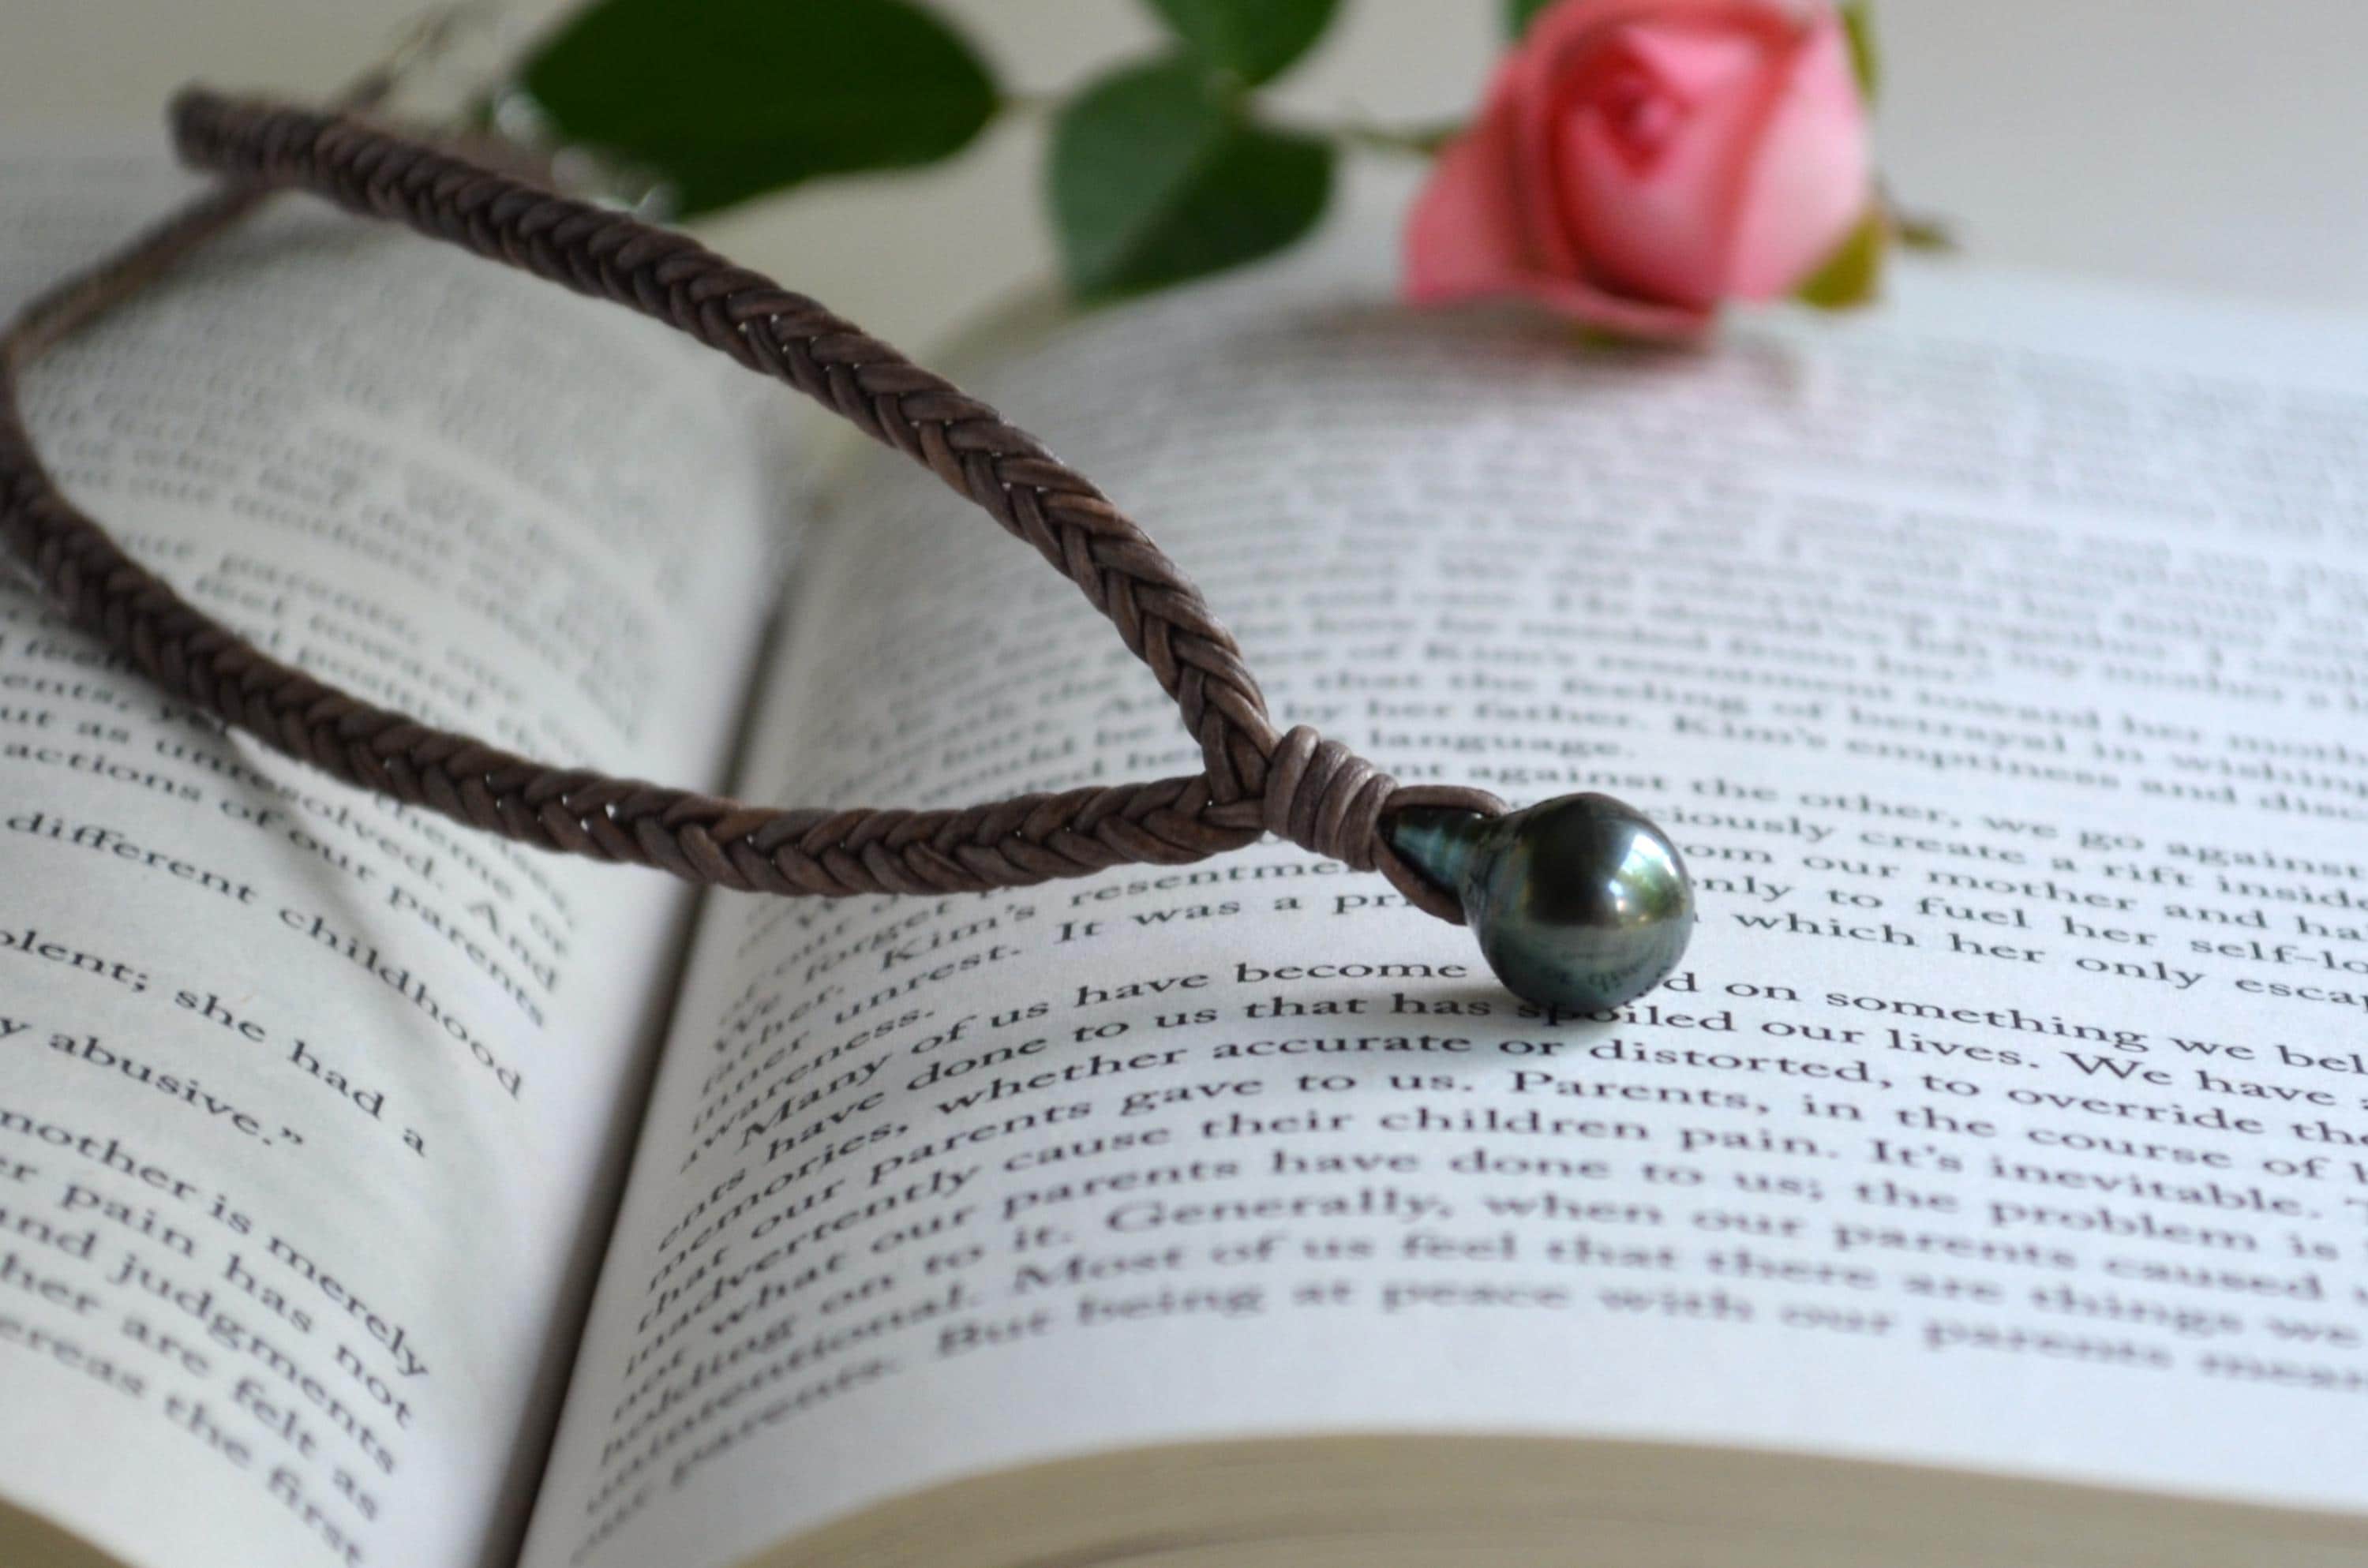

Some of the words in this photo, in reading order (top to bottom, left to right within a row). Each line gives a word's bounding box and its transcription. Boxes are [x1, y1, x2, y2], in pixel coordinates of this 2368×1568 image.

[1368, 728, 1639, 759] language.
[1672, 713, 1829, 751] Kim's
[1844, 735, 2122, 789] emptiness
[2138, 778, 2239, 805] and
[5, 743, 200, 802] actions
[219, 799, 285, 829] of
[288, 829, 377, 882] our
[388, 885, 545, 1028] parents
[77, 720, 129, 743] as
[466, 901, 559, 994] And
[1467, 761, 1665, 791] against
[1691, 777, 1781, 802] the
[1798, 791, 1962, 829] other,
[1980, 814, 2060, 840] we
[2078, 827, 2147, 854] go
[2165, 840, 2366, 882] against
[1654, 803, 1837, 844] ciously
[1858, 828, 2029, 866] create
[2050, 853, 2078, 873] a
[2102, 860, 2196, 889] rift
[6, 811, 259, 904] different
[279, 907, 525, 1102] childhood
[878, 902, 1036, 972] Kim's
[1070, 859, 1351, 909] resentme
[1692, 874, 1796, 904] nly
[1827, 885, 1885, 911] to
[1916, 895, 2034, 931] fuel
[2060, 912, 2160, 949] her
[1733, 911, 1921, 950] which
[1946, 931, 2048, 966] her
[2074, 953, 2207, 991] only
[1802, 853, 1901, 880] our
[1926, 868, 2139, 914] mother
[2161, 901, 2270, 930] and
[834, 945, 1022, 1026] unrest.
[1054, 919, 1099, 944] It
[1132, 894, 1242, 930] was
[1273, 896, 1301, 911] a
[174, 990, 266, 1043] she
[287, 1038, 385, 1121] had
[403, 1126, 427, 1157] a
[734, 1051, 894, 1157] Many
[911, 1014, 979, 1055] of
[990, 999, 1050, 1027] us
[1076, 971, 1209, 1009] have
[1236, 961, 1468, 983] become
[1724, 981, 1803, 1002] on
[1826, 990, 2150, 1054] something
[2168, 1035, 2256, 1061] we
[762, 1091, 886, 1164] have
[906, 1034, 1047, 1091] done
[1072, 1018, 1130, 1042] to
[1154, 1009, 1218, 1029] us
[1245, 993, 1369, 1019] that
[1388, 993, 1492, 1017] has
[1516, 997, 1735, 1031] spoiled
[1761, 1020, 1865, 1044] our
[1887, 1028, 2040, 1068] lives.
[2060, 1050, 2172, 1085] We
[2196, 1069, 2338, 1106] have
[935, 1043, 1187, 1117] whether
[1213, 1032, 1472, 1059] accurate
[1499, 1039, 1564, 1058] or
[1589, 1038, 1894, 1090] distorted,
[1920, 1073, 1980, 1097] to
[2007, 1088, 2265, 1134] override
[751, 1180, 845, 1241] our
[868, 1103, 1091, 1188] parents
[1119, 1077, 1263, 1117] gave
[1297, 1072, 1356, 1093] to
[1388, 1074, 1474, 1093] us.
[1509, 1070, 1770, 1114] Parents,
[1800, 1093, 1864, 1122] in
[1896, 1106, 1998, 1138] the
[2027, 1128, 2234, 1169] course
[2261, 1156, 2332, 1181] of
[1002, 1125, 1171, 1174] cause
[1201, 1109, 1355, 1141] their
[1379, 1108, 1650, 1142] children
[1680, 1126, 1841, 1160] pain.
[1868, 1137, 1963, 1173] It's
[1989, 1153, 2323, 1220] inevitable.
[58, 1184, 196, 1258] pain
[223, 1253, 313, 1335] has
[335, 1344, 412, 1428] not
[209, 1192, 253, 1236] is
[268, 1235, 429, 1380] merely
[709, 1247, 851, 1335] what
[870, 1203, 979, 1256] our
[1001, 1158, 1241, 1222] parents
[1272, 1149, 1422, 1175] have
[1448, 1149, 1613, 1181] done
[1642, 1162, 1706, 1185] to
[1733, 1173, 1825, 1202] us;
[1855, 1181, 1961, 1211] the
[1988, 1199, 2259, 1253] problem
[2286, 1231, 2341, 1263] is
[818, 1270, 897, 1316] on
[924, 1243, 985, 1276] to
[1014, 1225, 1075, 1255] it.
[1107, 1185, 1456, 1233] Generally,
[1483, 1191, 1664, 1226] when
[1691, 1207, 1808, 1238] our
[1831, 1219, 2080, 1272] parents
[2101, 1256, 2325, 1304] caused
[1011, 1245, 1186, 1296] Most
[1209, 1234, 1287, 1265] of
[1302, 1236, 1377, 1260] us
[1400, 1232, 1519, 1261] feel
[1546, 1233, 1678, 1270] that
[1704, 1246, 1879, 1290] there
[1901, 1272, 2006, 1303] are
[2029, 1283, 2243, 1340] things
[2261, 1314, 2364, 1351] we
[1075, 1282, 1268, 1328] being
[105, 1252, 396, 1476] judgments
[121, 1316, 210, 1378] are
[231, 1377, 317, 1458] felt
[332, 1466, 379, 1523] as
[163, 1393, 253, 1469] the
[267, 1464, 363, 1566] first
